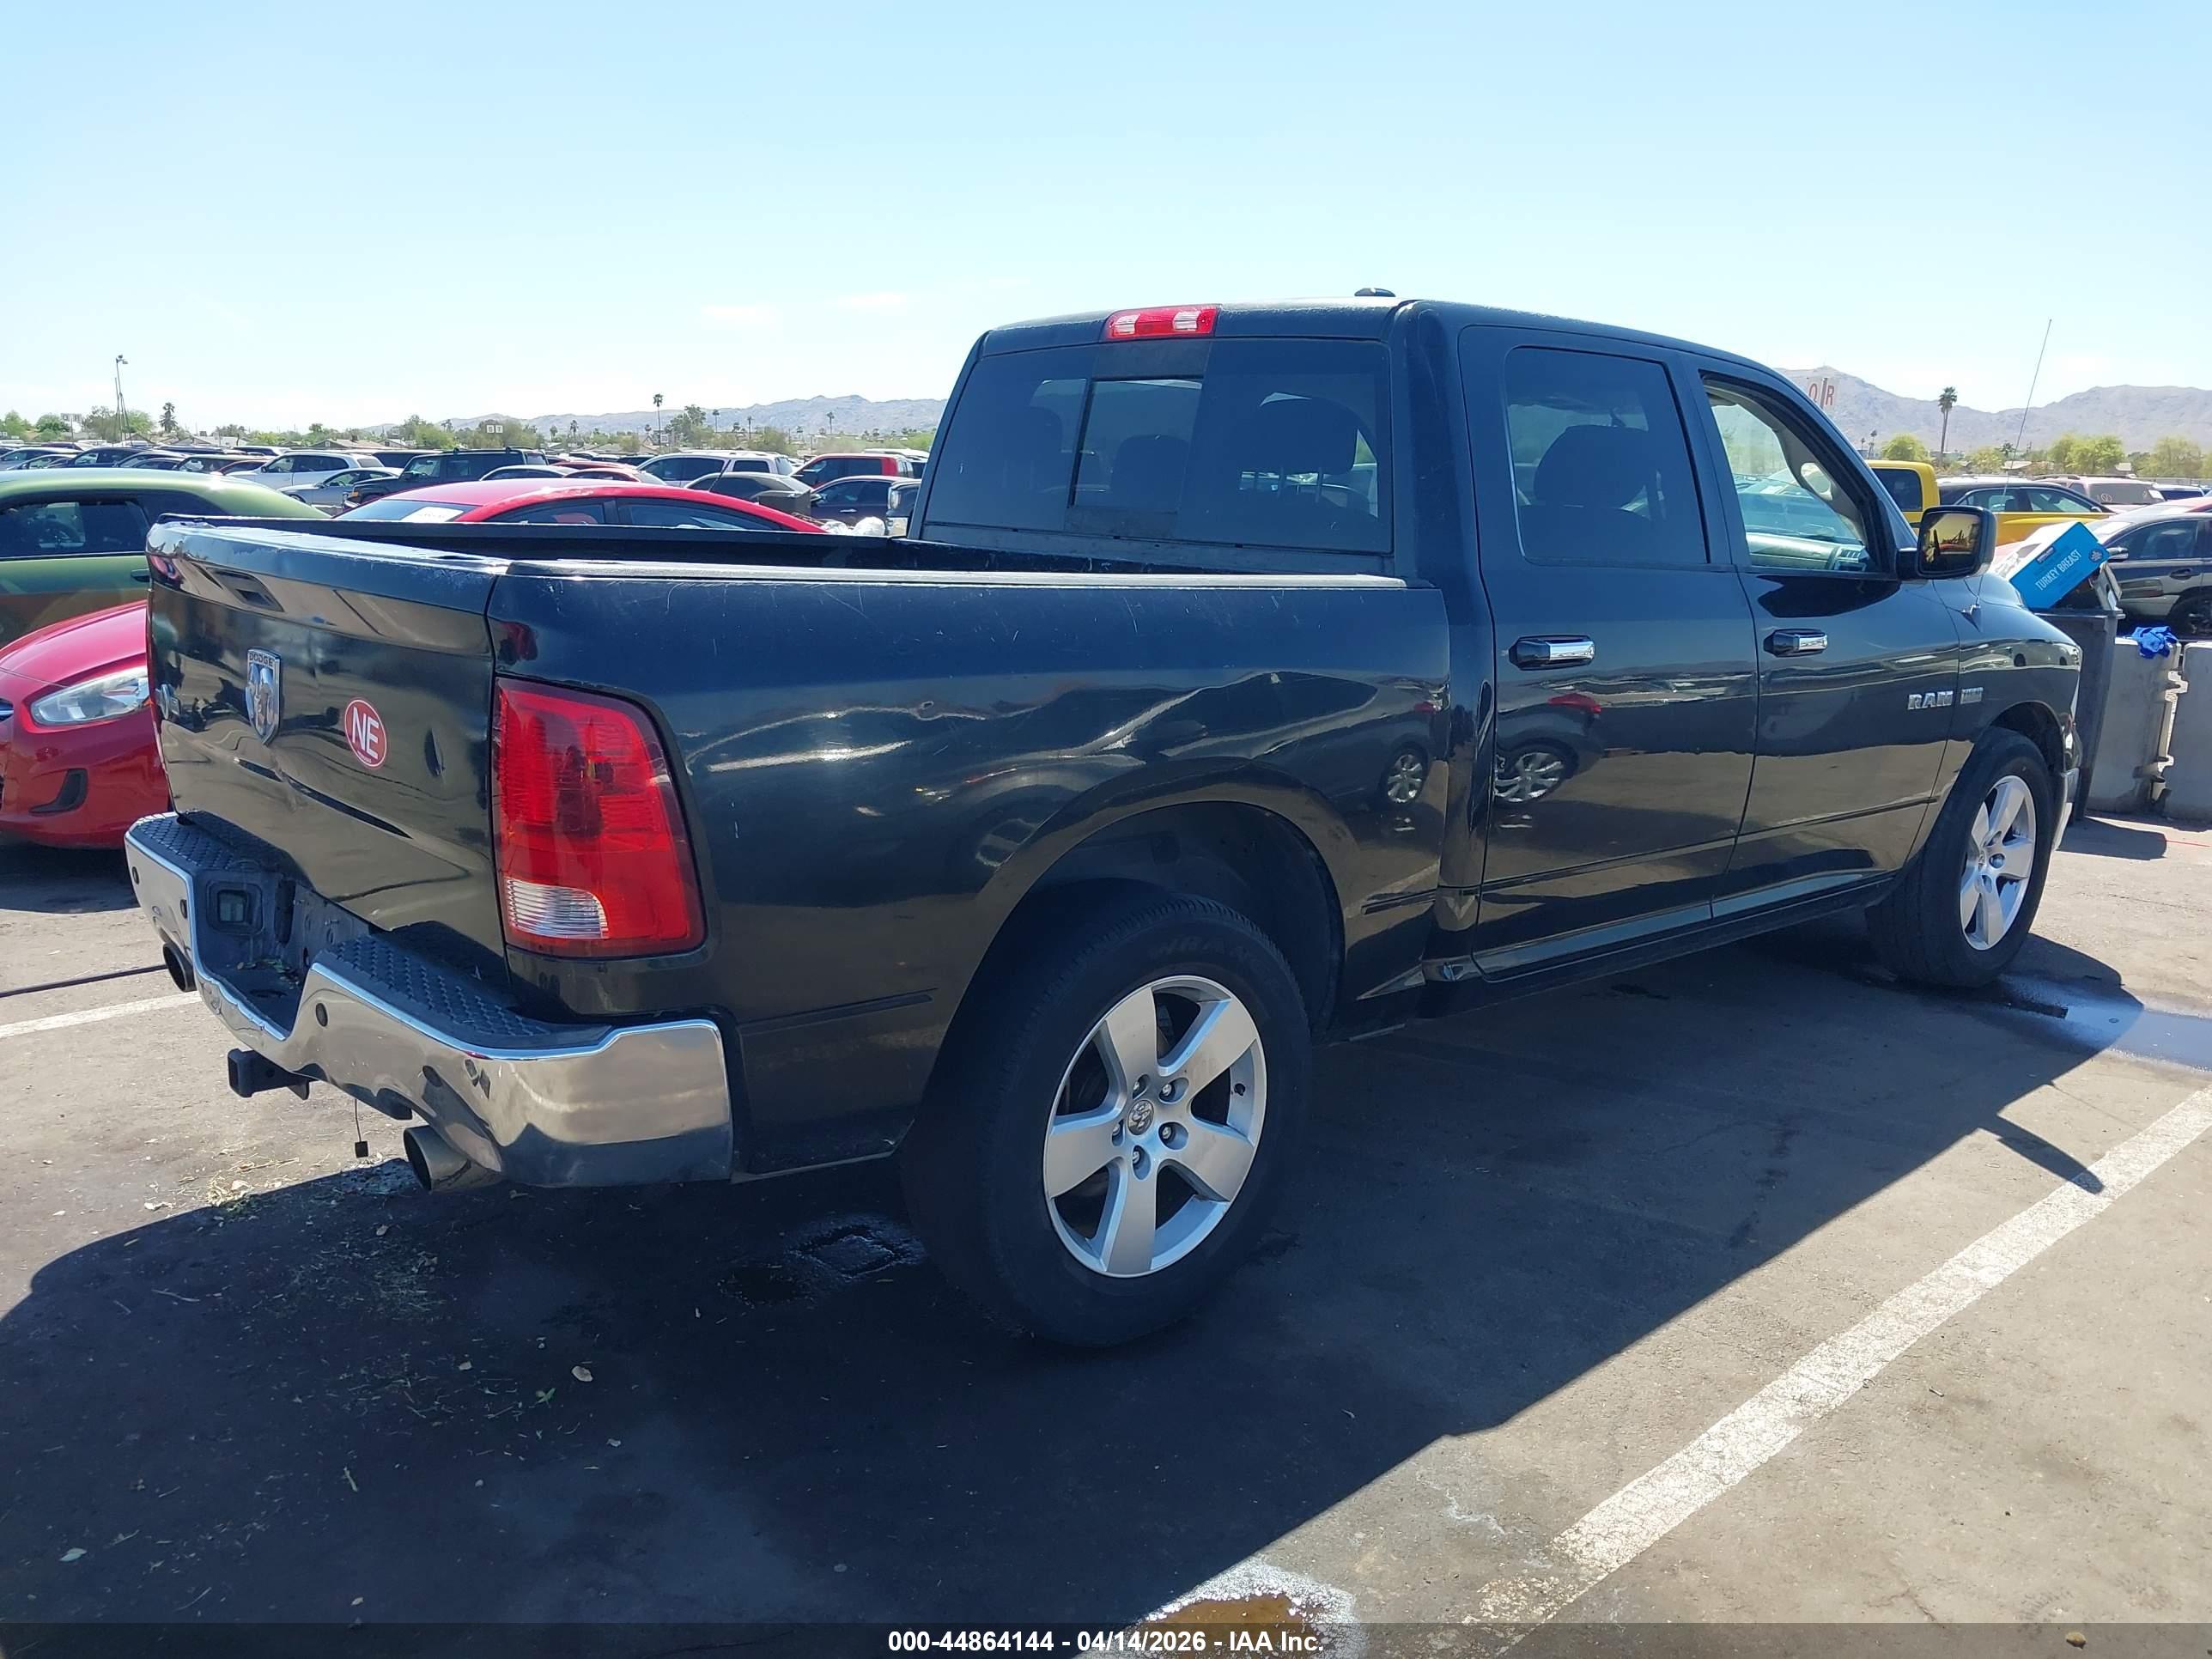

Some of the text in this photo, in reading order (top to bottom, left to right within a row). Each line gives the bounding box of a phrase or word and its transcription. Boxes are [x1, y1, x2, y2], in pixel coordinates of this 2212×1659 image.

[1826, 385, 1835, 406] R
[2035, 567, 2060, 591] TURKEY
[2057, 549, 2082, 573] BREAST
[249, 652, 274, 667] DODGE
[1908, 690, 1954, 710] RAM
[352, 706, 380, 760] NE
